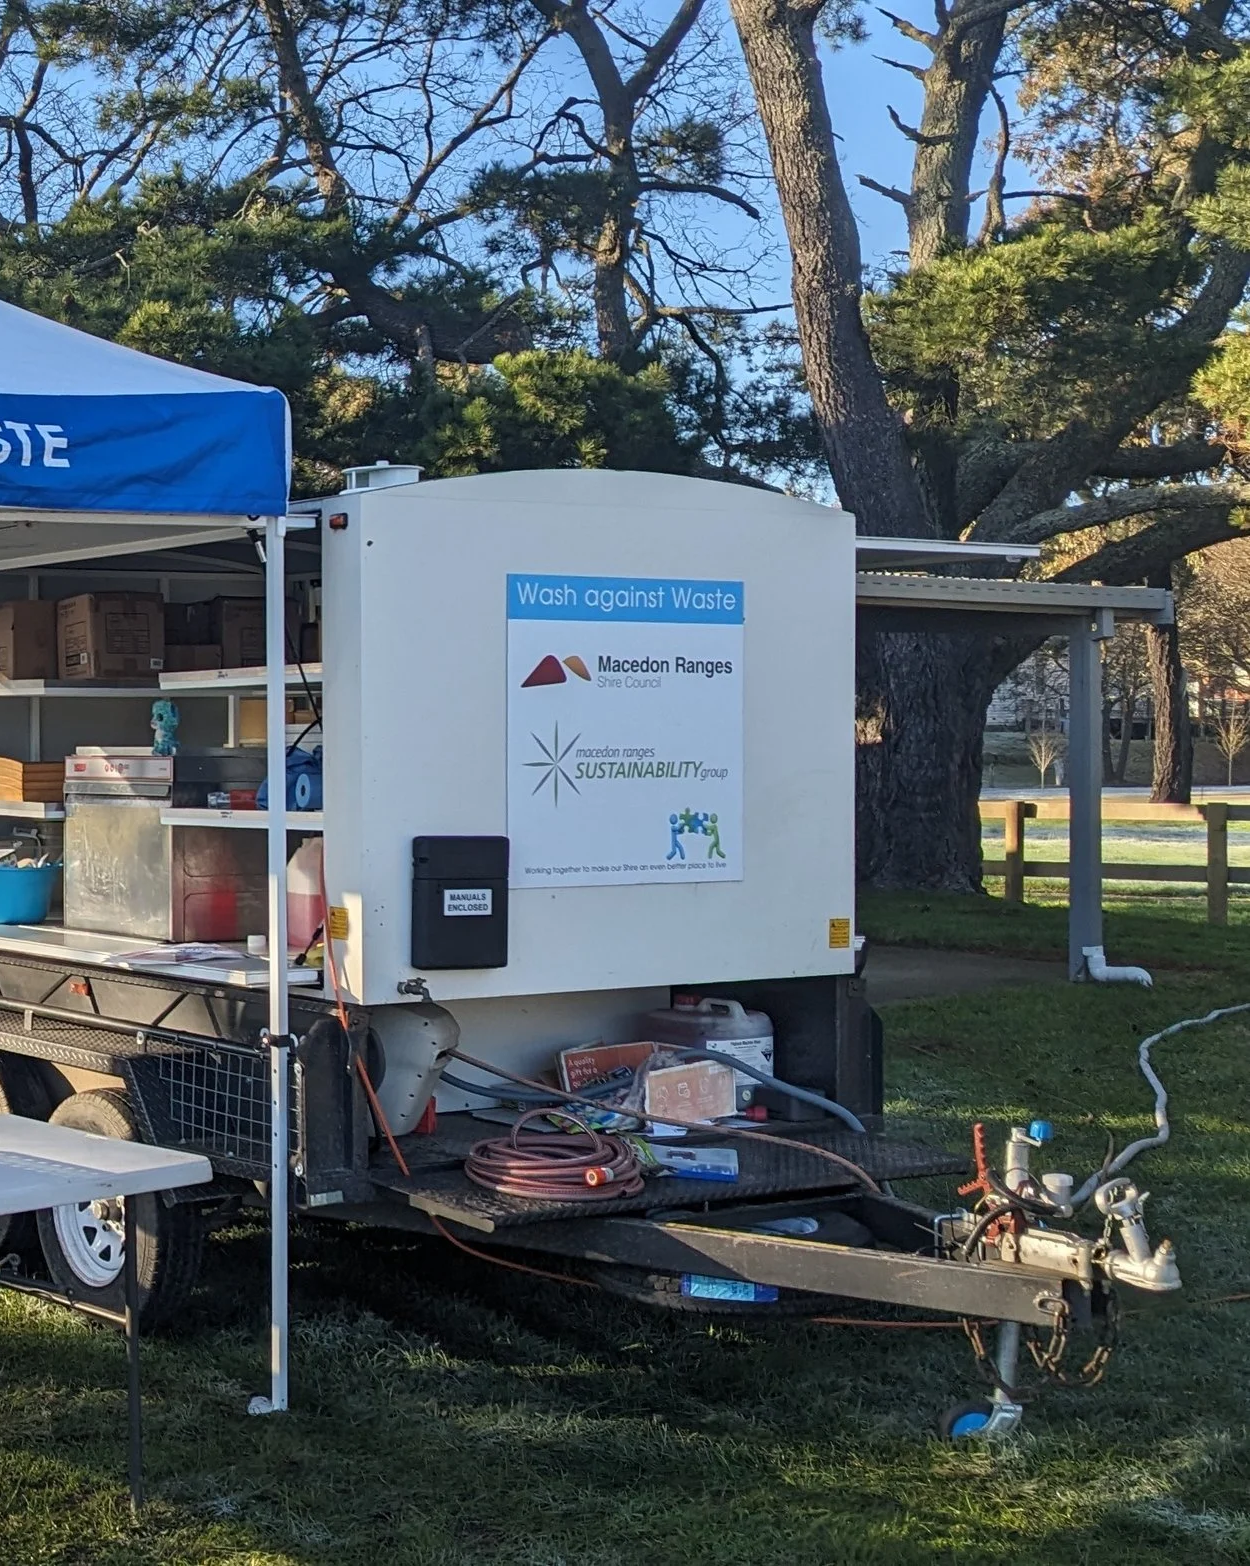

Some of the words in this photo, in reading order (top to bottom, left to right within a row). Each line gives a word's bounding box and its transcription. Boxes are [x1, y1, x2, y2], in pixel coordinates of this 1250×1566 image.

[517, 582, 577, 605] Wash
[584, 586, 665, 612] against
[671, 586, 736, 611] Waste
[597, 655, 670, 674] Macedon
[675, 656, 733, 678] Ranges
[597, 676, 622, 689] Shire
[624, 675, 662, 689] Council
[575, 745, 620, 759] macedon
[622, 747, 655, 761] ranges
[575, 761, 703, 779] SUSTAINABILITY
[700, 767, 729, 781] group
[524, 867, 551, 875] Working
[552, 866, 581, 875] together
[687, 862, 707, 871] place
[450, 893, 486, 901] MANUALS
[447, 903, 489, 911] ENCLOSED
